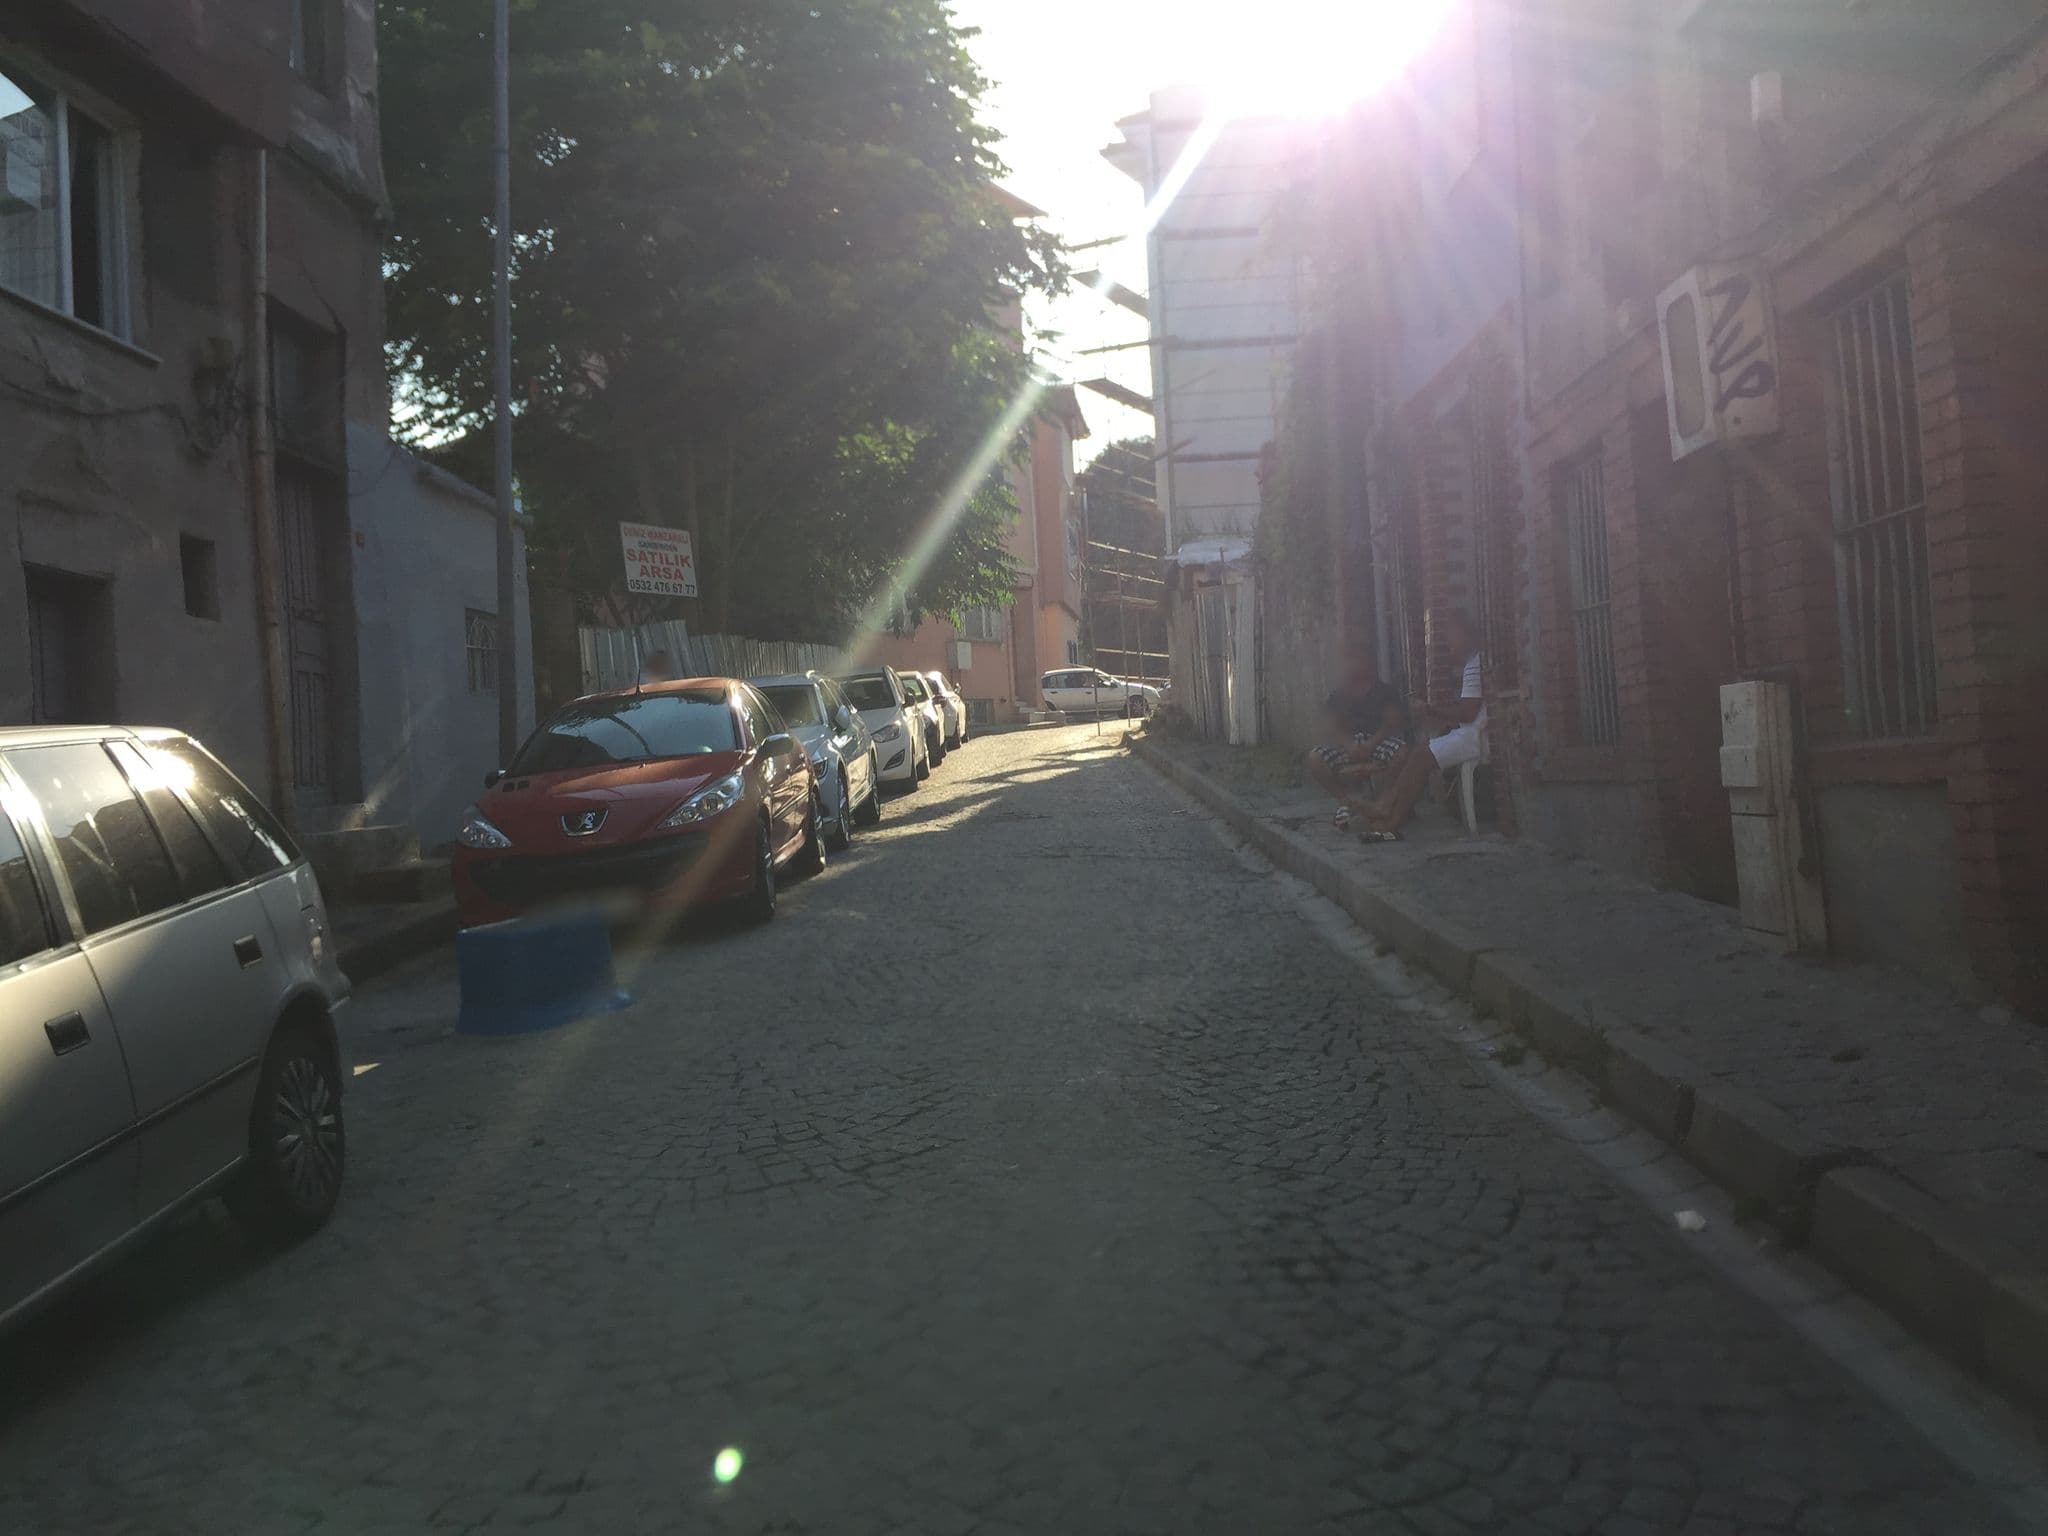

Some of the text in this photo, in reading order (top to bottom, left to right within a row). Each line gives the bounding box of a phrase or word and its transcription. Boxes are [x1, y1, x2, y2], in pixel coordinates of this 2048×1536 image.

[626, 548, 692, 568] SATILIK
[639, 565, 684, 581] ARSA
[629, 579, 652, 591] 0532
[654, 581, 670, 592] 476
[685, 584, 695, 594] 77
